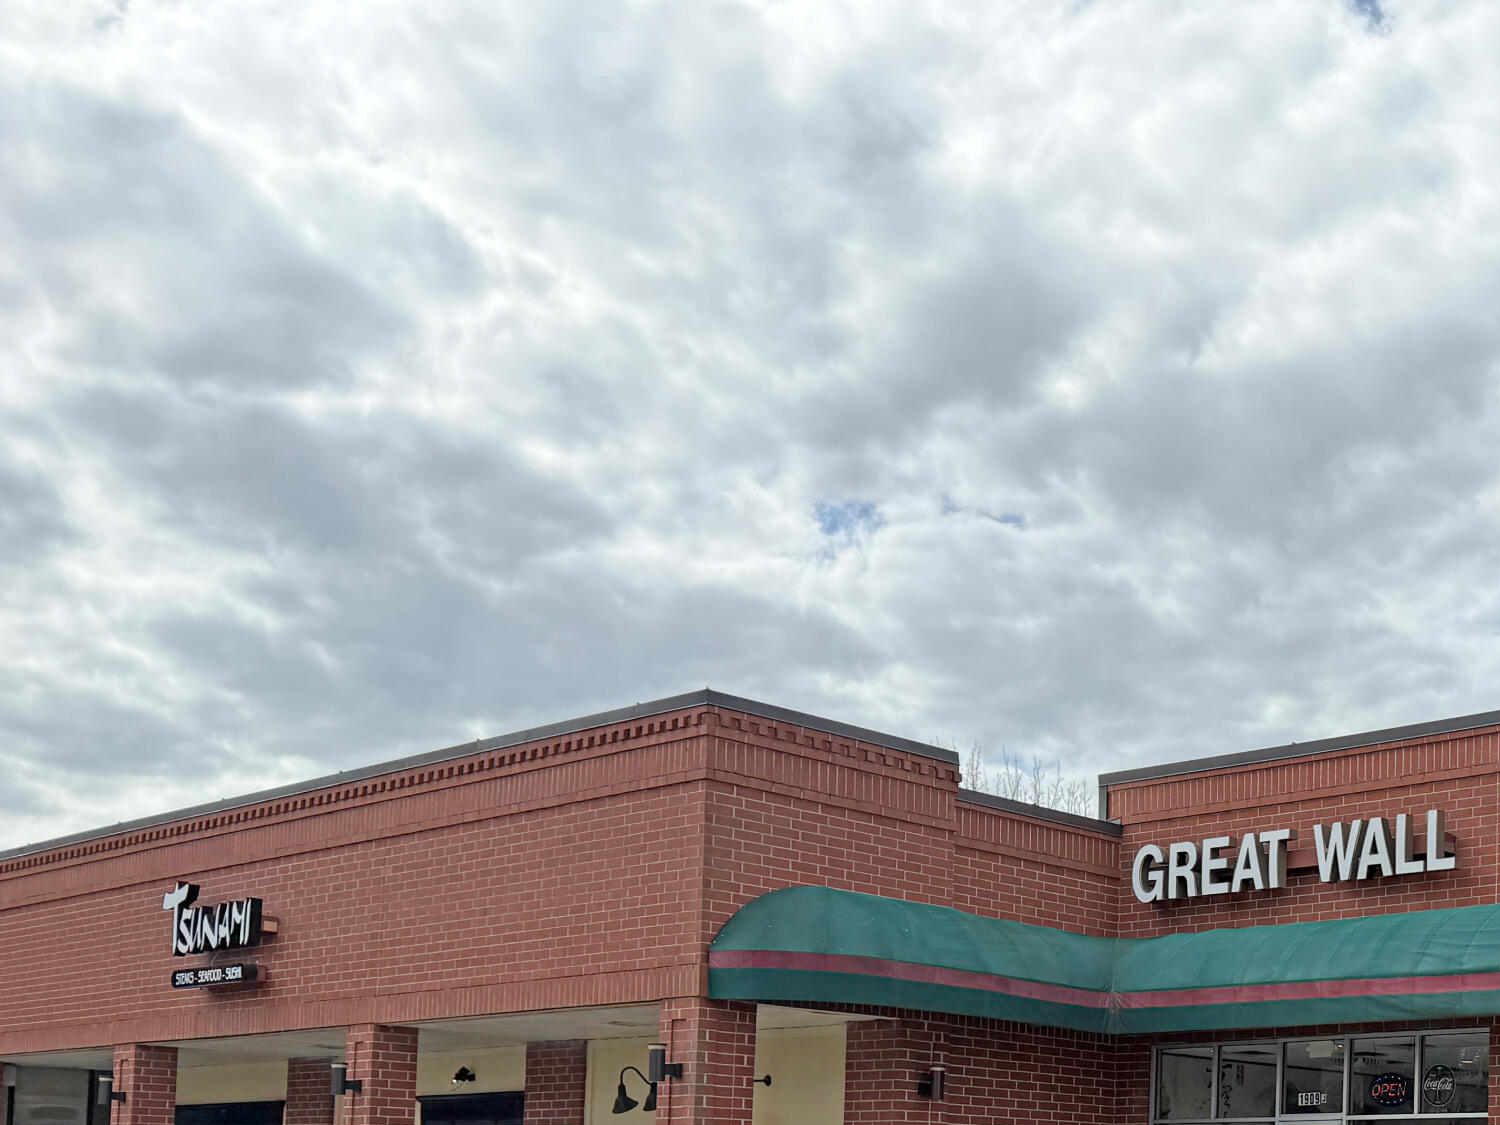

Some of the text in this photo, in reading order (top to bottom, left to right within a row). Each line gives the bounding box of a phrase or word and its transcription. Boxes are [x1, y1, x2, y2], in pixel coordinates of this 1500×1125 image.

[1132, 809, 1456, 904] GREAT WALL
[163, 882, 253, 955] TSUNAMI
[175, 971, 194, 986] STEAKS
[197, 968, 222, 983] SEAFOOD
[225, 966, 242, 980] SUSHI
[1299, 1092, 1320, 1105] 1909
[1371, 1083, 1406, 1098] OPEN
